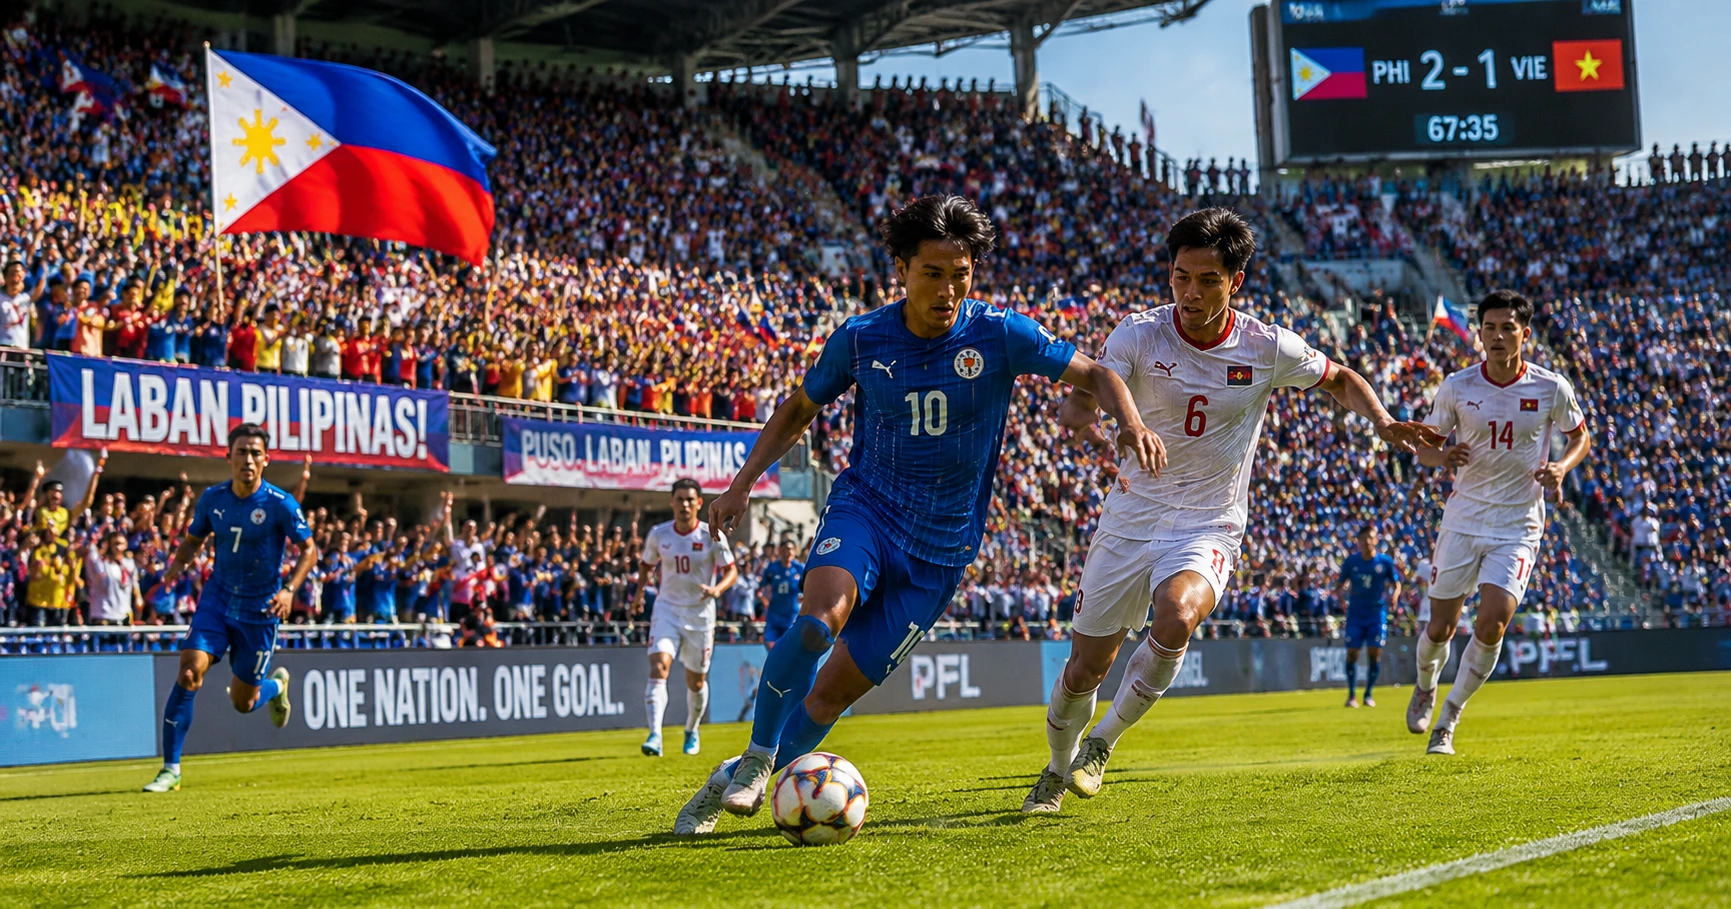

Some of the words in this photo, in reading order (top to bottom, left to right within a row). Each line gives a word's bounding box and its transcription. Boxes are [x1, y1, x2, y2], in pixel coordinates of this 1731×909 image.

[1372, 60, 1411, 84] PHI
[1420, 50, 1446, 90] 2
[1477, 49, 1497, 89] 1
[1510, 55, 1548, 80] VIE
[1427, 114, 1499, 141] 67:35
[81, 368, 228, 446] LABAN
[241, 382, 428, 459] PILIPINAS!
[905, 390, 948, 436] 10
[1184, 394, 1209, 437] 6
[1488, 421, 1514, 450] 14
[230, 527, 243, 553] 7
[674, 555, 690, 574] 10
[303, 668, 368, 730] ONE
[374, 666, 488, 726] NATION.
[494, 664, 548, 721] ONE
[552, 662, 625, 718] GOAL.
[911, 653, 982, 700] PFL
